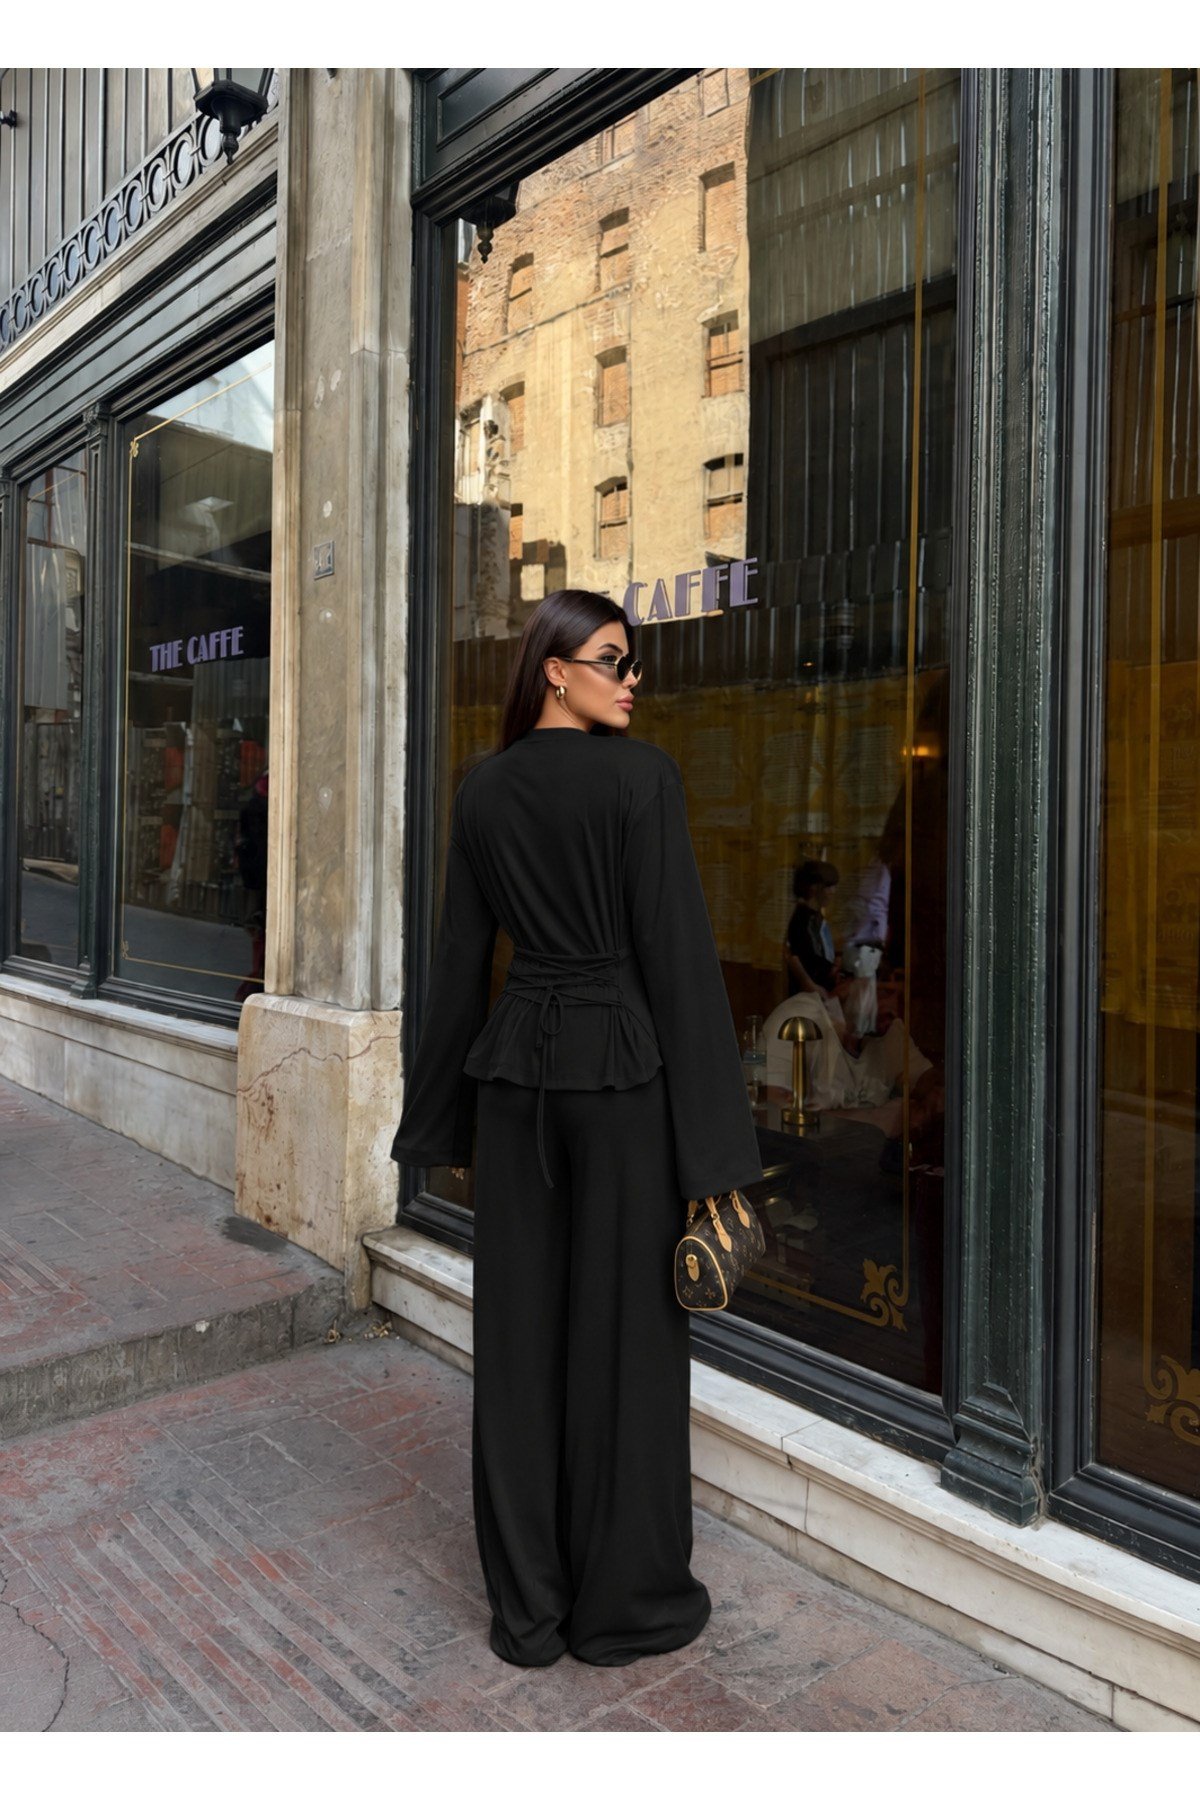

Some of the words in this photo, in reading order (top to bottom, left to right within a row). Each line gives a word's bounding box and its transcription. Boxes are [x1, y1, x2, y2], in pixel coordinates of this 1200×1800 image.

[622, 557, 758, 627] CAFFE
[149, 639, 183, 673] THE
[186, 626, 244, 665] CAFFE
